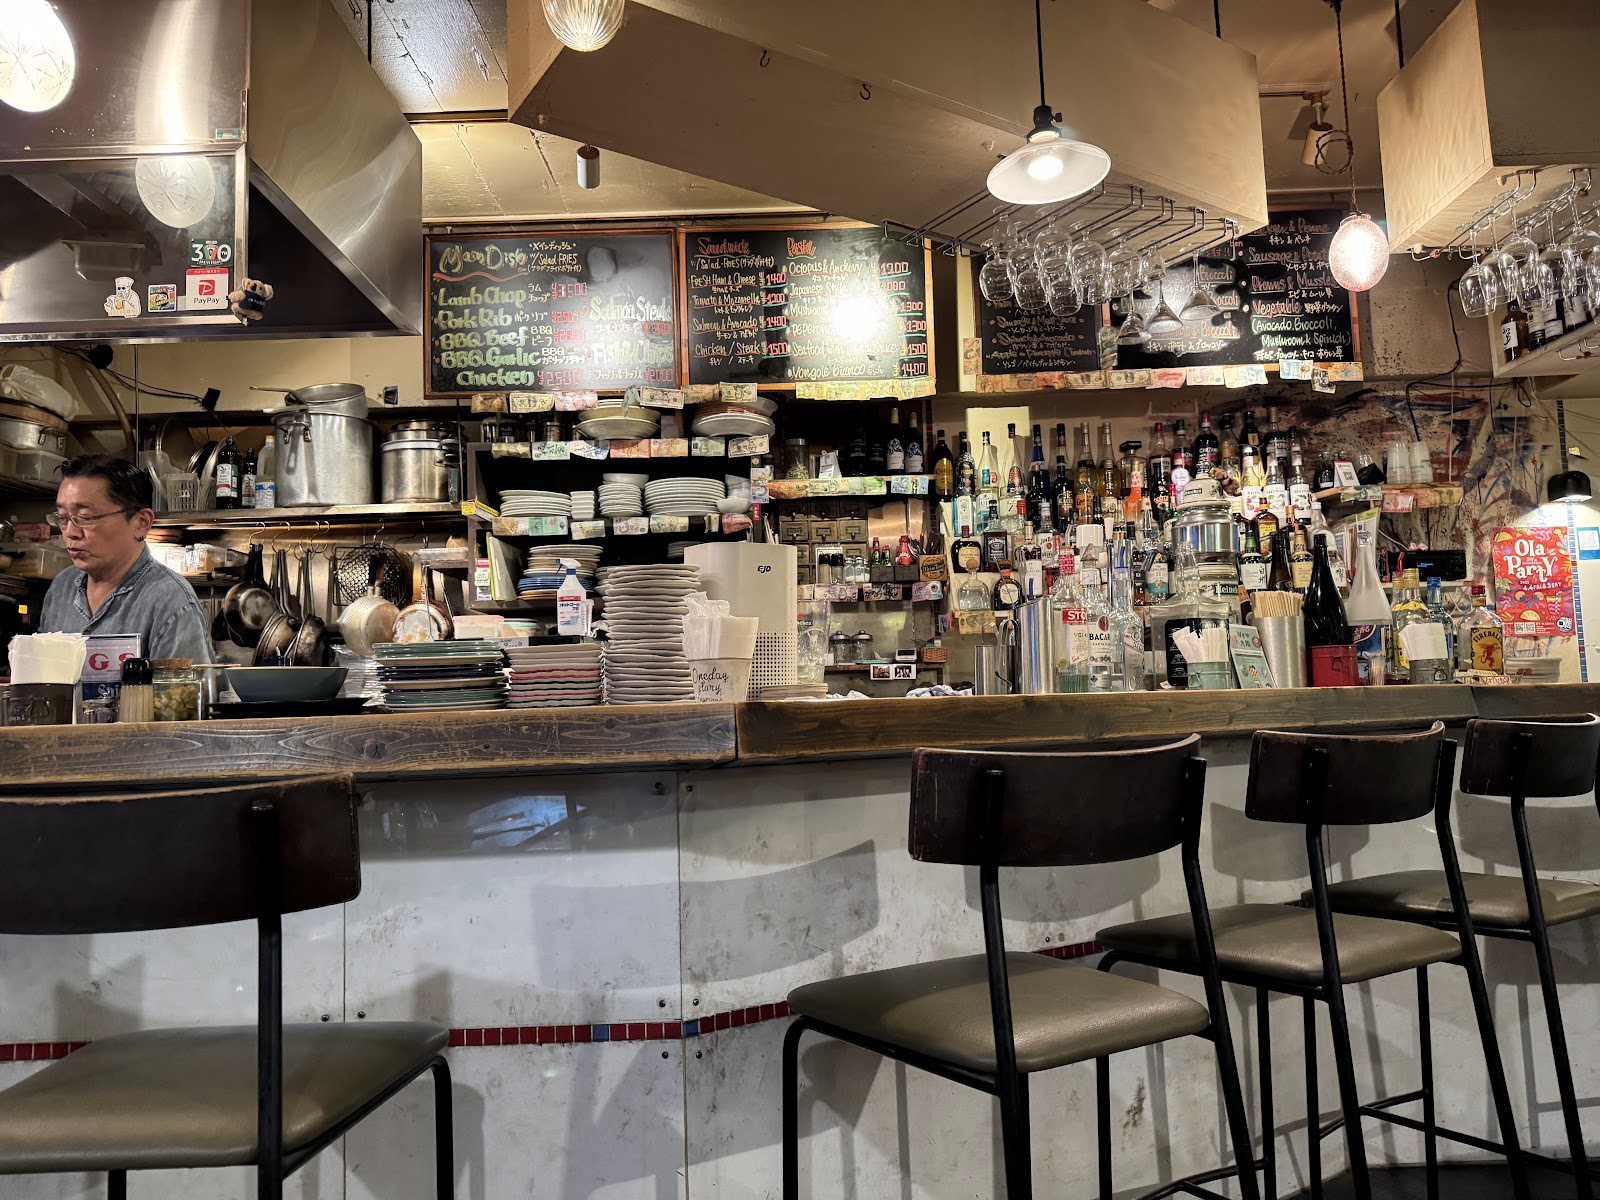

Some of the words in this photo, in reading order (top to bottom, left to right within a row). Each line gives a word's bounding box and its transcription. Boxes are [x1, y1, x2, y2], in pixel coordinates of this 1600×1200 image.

[1248, 247, 1292, 265] Sausage
[1301, 246, 1329, 262] Potat
[789, 261, 822, 275] Octopus
[1199, 264, 1234, 281] Broccoli
[712, 274, 726, 284] Ham
[733, 272, 756, 285] Cheese
[758, 271, 786, 286] ¥1400
[438, 286, 483, 307] Lamb
[789, 283, 824, 298] Japanese
[826, 281, 848, 298] Style
[193, 297, 220, 305] PayPay
[1252, 298, 1303, 318] Vegetable
[438, 308, 478, 329] Pork
[478, 308, 513, 327] Rib
[727, 316, 757, 328] Avocado
[759, 316, 787, 329] ¥1400
[996, 315, 1031, 329] Sausage
[530, 325, 553, 335] BBQ
[1200, 320, 1238, 338] Broccoli
[439, 331, 486, 350] BBQ
[484, 325, 530, 347] Beef
[531, 334, 552, 346] ビーフ
[1261, 334, 1306, 347] Mushroom
[541, 347, 565, 356] BBQ
[695, 342, 728, 356] Chicken
[735, 340, 761, 355] Steak
[761, 341, 788, 356] ¥1500
[792, 339, 827, 357] Seafood
[873, 339, 898, 354] Sauce
[900, 342, 927, 356] ¥1500
[440, 349, 487, 369] BBQ
[486, 347, 541, 368] Garlic
[456, 368, 535, 387] Chicken
[792, 365, 829, 380] Vongole
[832, 364, 866, 377] bianco
[892, 363, 926, 377] ¥1400
[1514, 538, 1546, 557] Ola
[1067, 610, 1086, 620] STO
[1089, 633, 1110, 641] BACAR
[1472, 631, 1501, 643] FIREBALL
[88, 653, 109, 671] G
